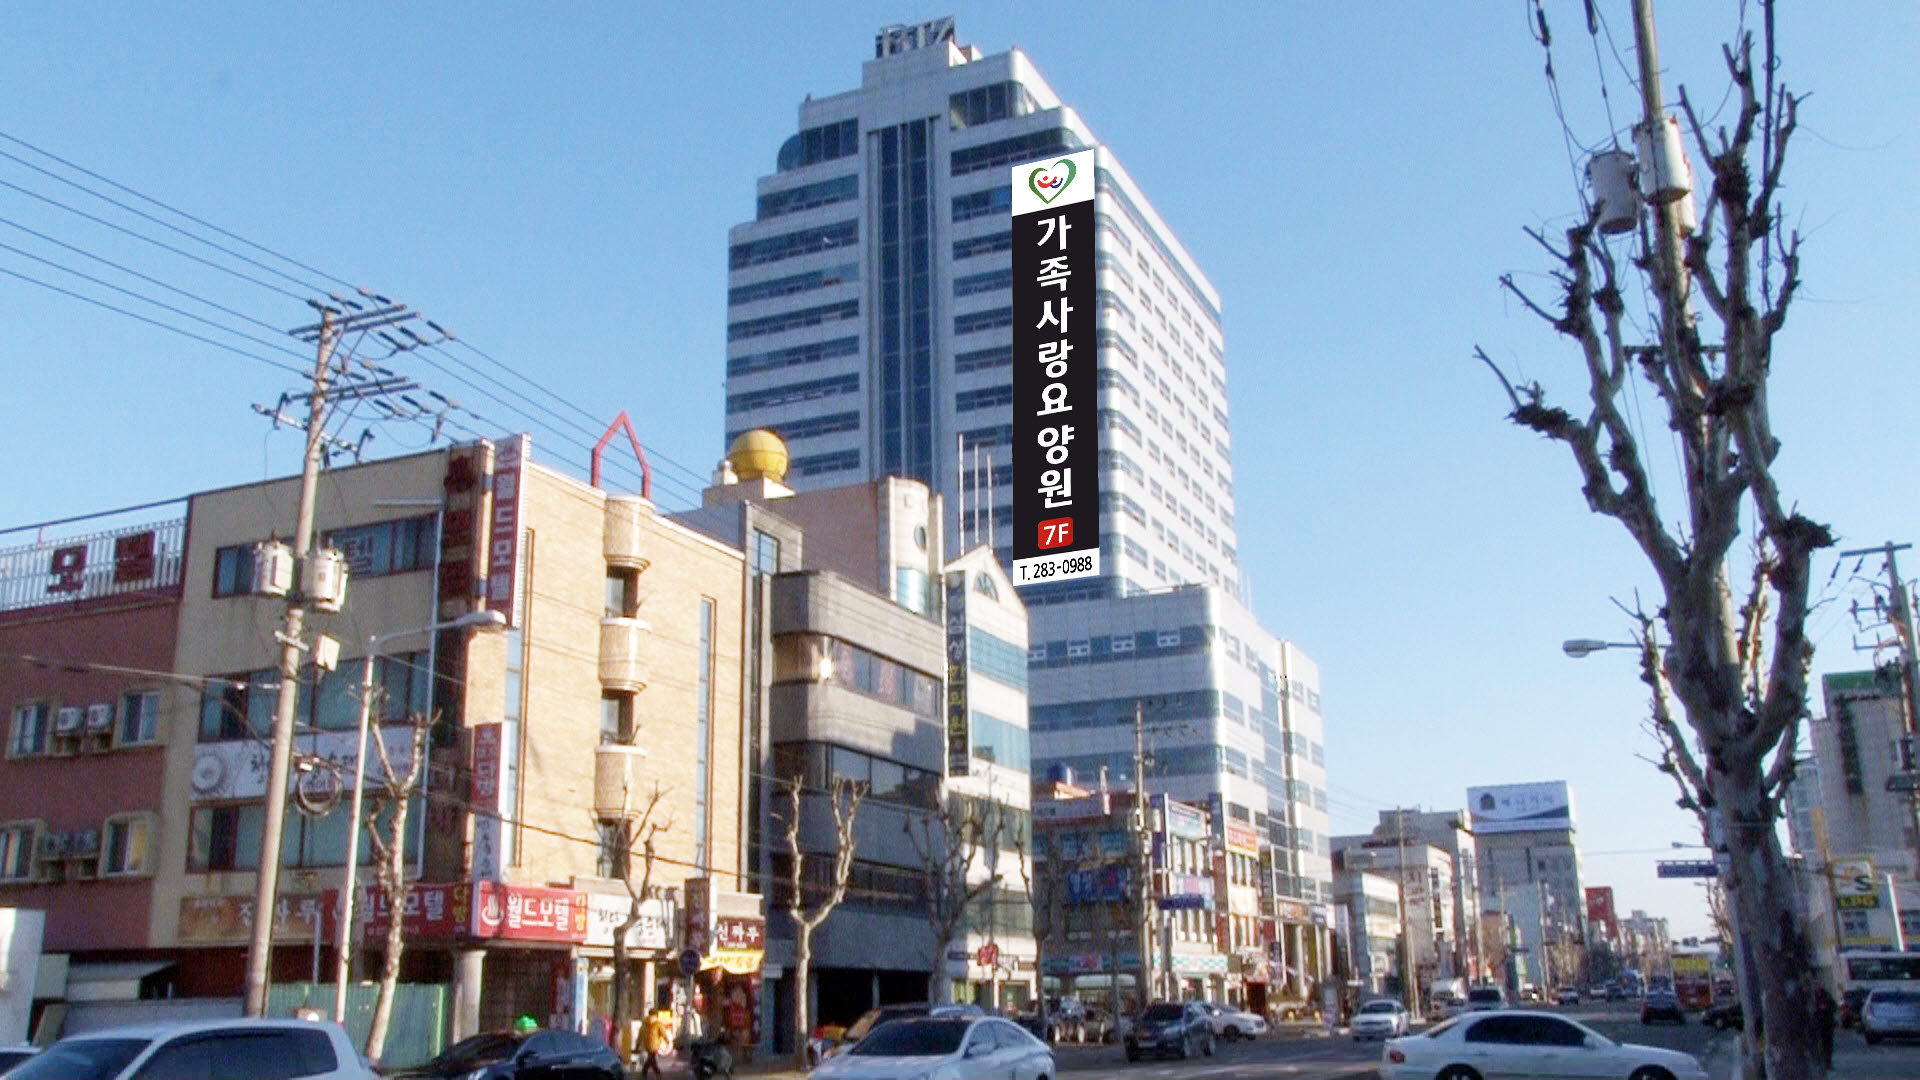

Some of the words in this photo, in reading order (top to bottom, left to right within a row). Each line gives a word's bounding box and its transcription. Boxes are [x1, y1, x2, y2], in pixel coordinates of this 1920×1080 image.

[1036, 215, 1074, 509] 가족사랑요양원
[1043, 523, 1069, 545] 7F
[1033, 556, 1092, 578] 283-0988
